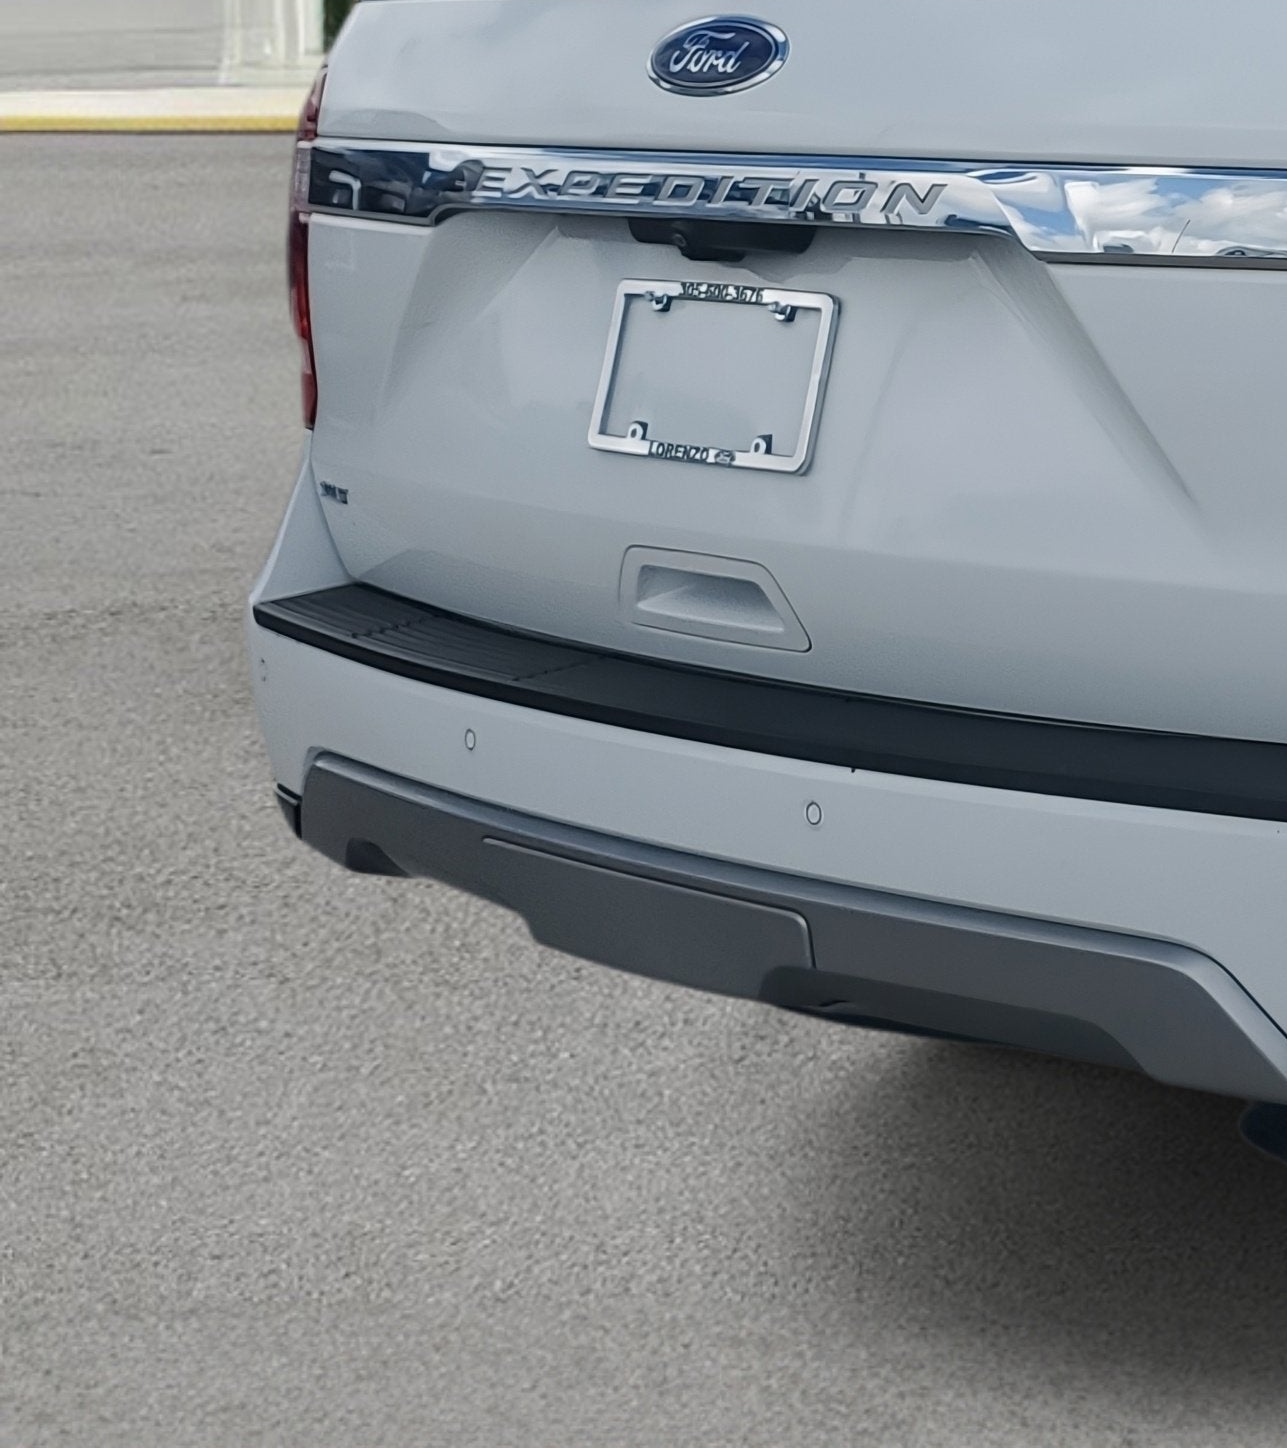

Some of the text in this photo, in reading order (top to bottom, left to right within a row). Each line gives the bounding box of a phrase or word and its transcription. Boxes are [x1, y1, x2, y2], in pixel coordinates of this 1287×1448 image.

[669, 30, 750, 73] Ford
[471, 165, 949, 216] EXPEDITION
[648, 441, 710, 462] LORENZO
